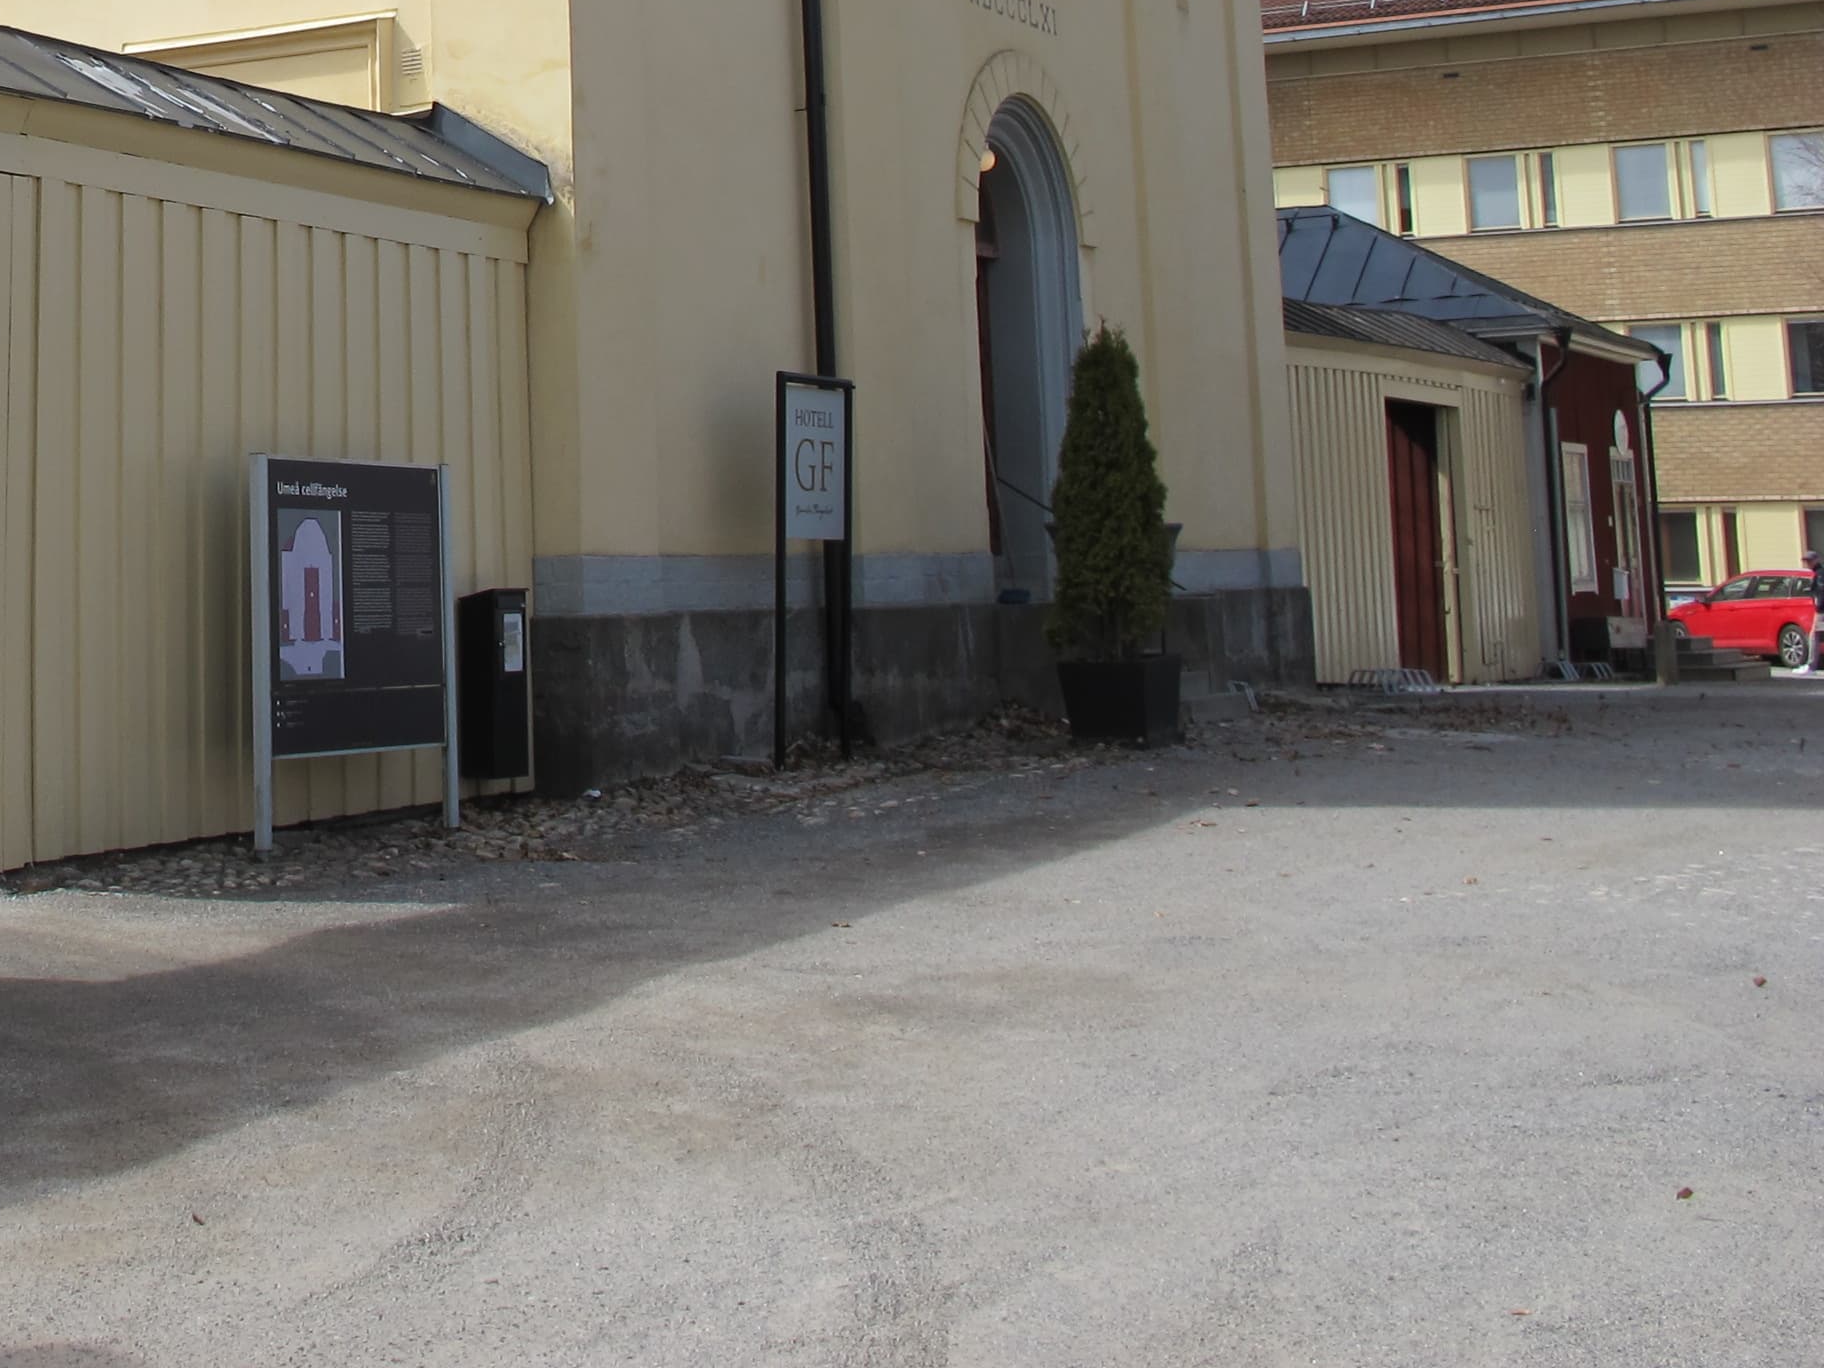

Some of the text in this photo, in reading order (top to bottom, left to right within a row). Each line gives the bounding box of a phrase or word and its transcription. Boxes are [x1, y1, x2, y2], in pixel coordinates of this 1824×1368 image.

[794, 408, 834, 429] HOTELL
[795, 438, 834, 492] GF
[277, 480, 300, 495] Umeå
